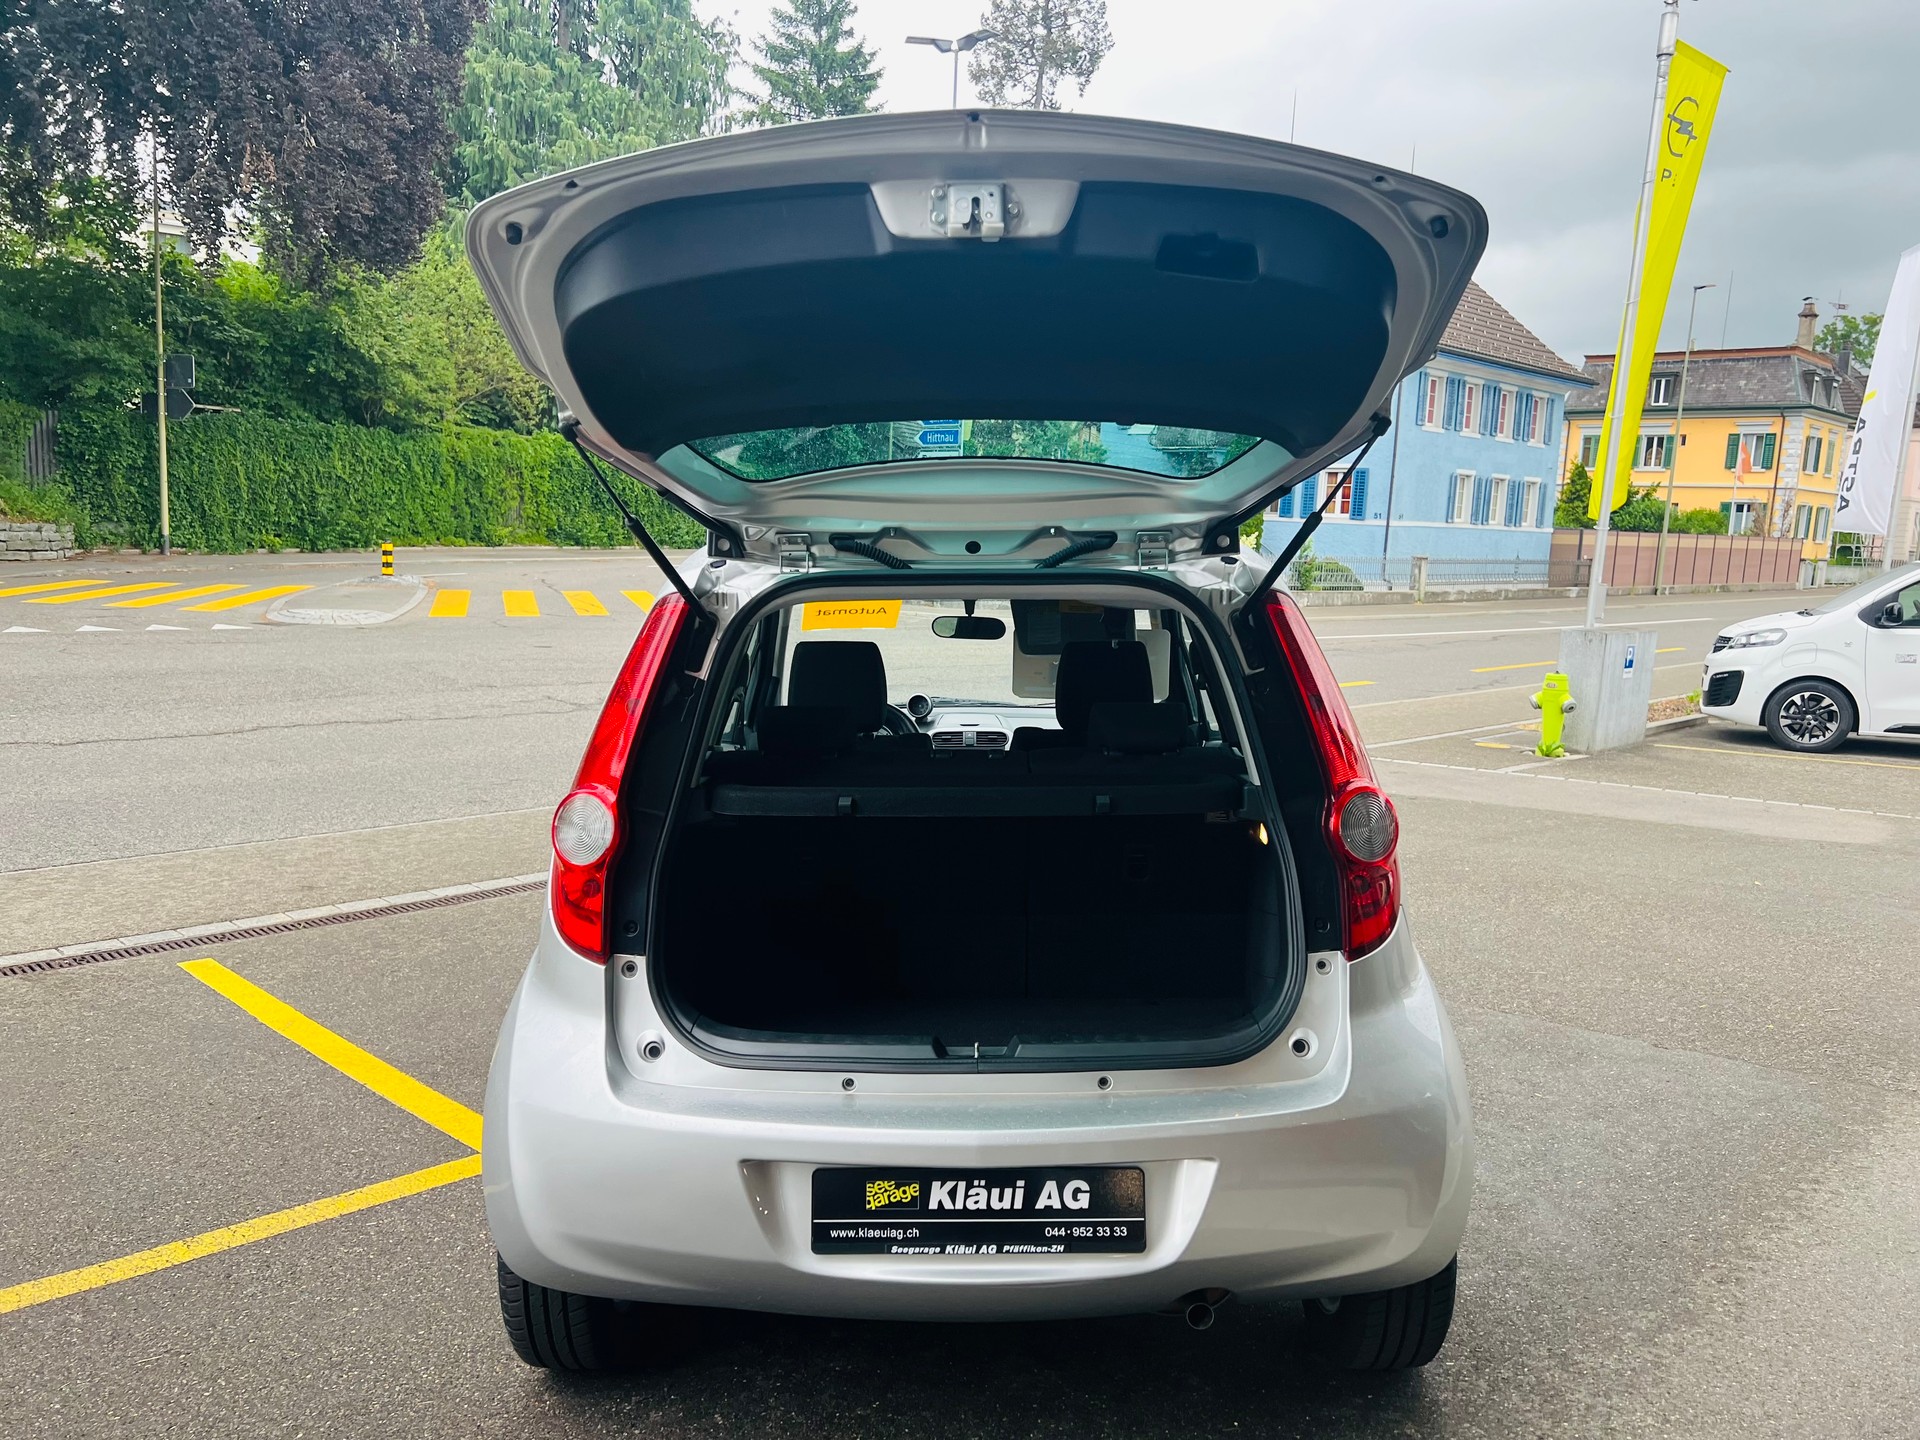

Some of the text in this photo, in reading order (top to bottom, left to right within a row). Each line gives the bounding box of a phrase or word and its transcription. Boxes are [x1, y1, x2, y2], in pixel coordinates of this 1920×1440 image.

[927, 432, 954, 443] Hittnau
[928, 1179, 1091, 1210] Kläui AG
[830, 1227, 920, 1239] www.klaeuiag.ch
[1096, 1226, 1110, 1237] 33
[1113, 1226, 1127, 1237] 33
[891, 1244, 1065, 1255] Seegarage Kläui AG Pfäffikon-ZH
